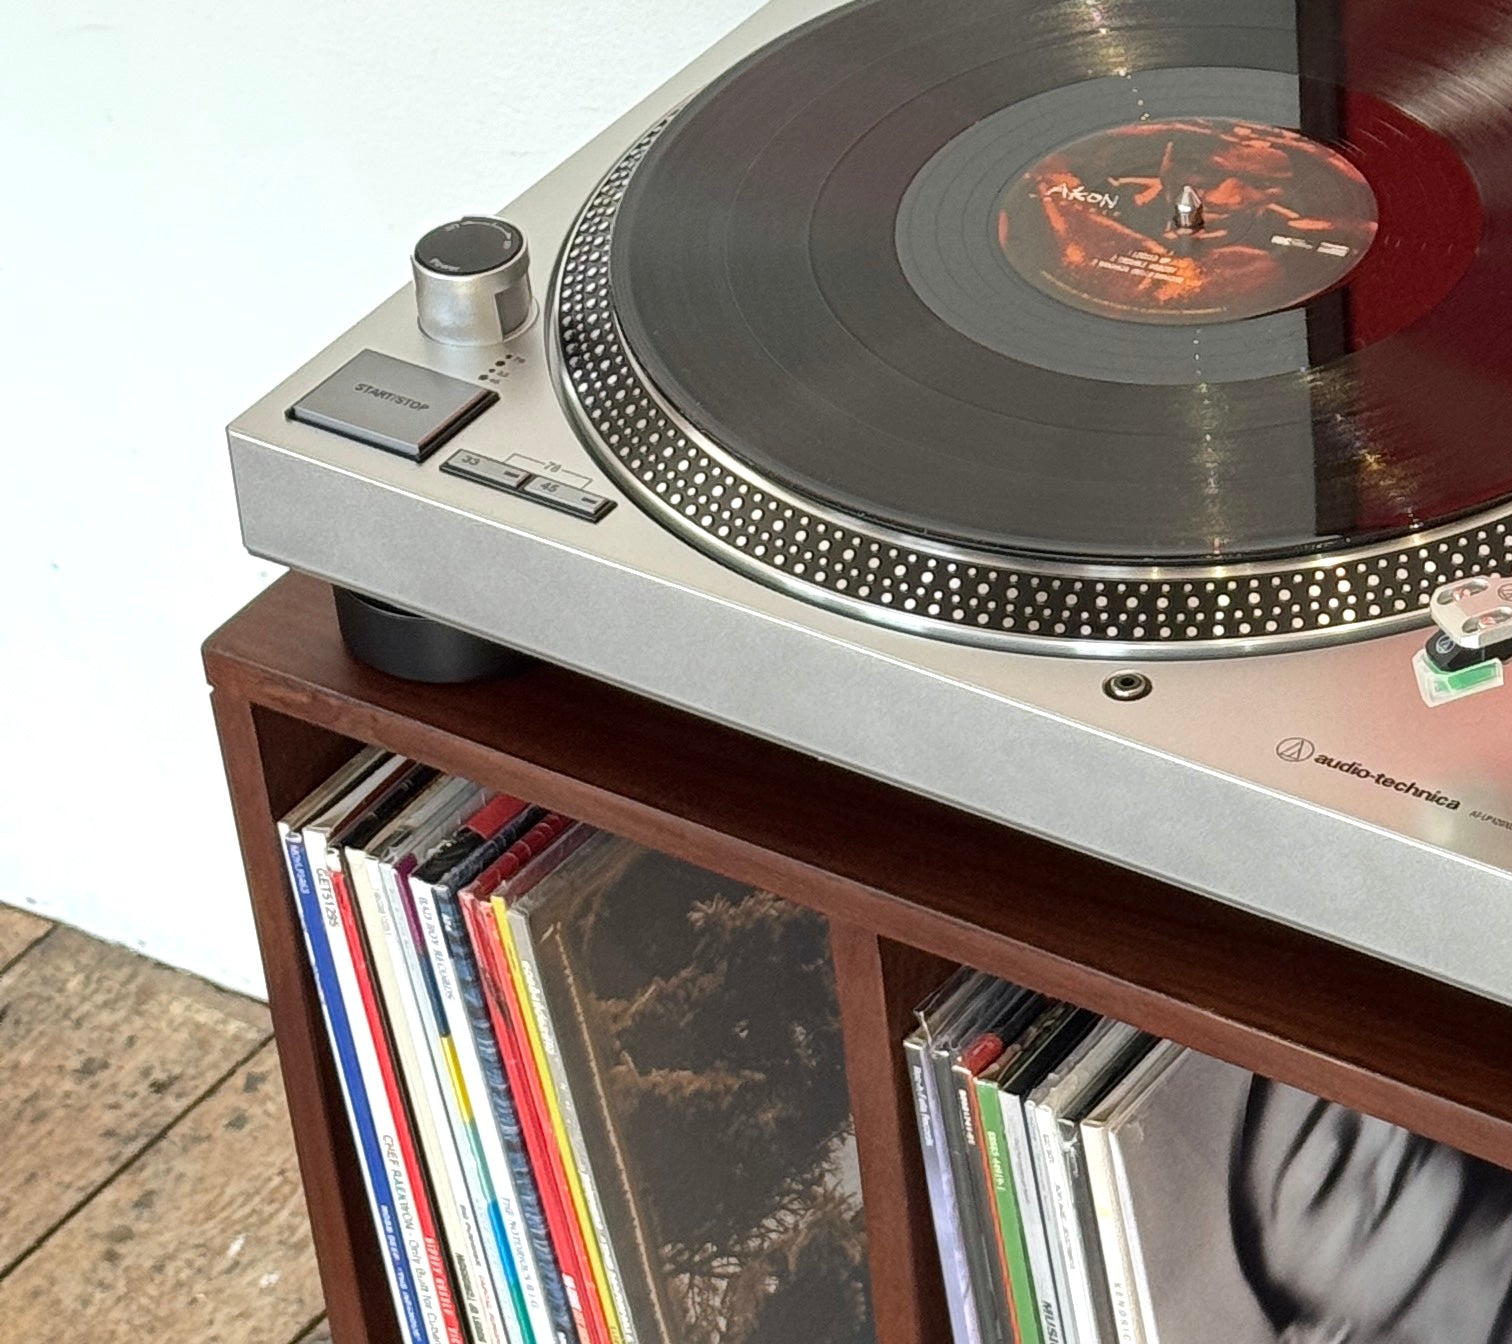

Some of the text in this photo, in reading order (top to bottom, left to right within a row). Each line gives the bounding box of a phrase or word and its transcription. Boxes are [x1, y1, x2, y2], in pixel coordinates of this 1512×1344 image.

[353, 382, 431, 413] START/STOP
[540, 481, 560, 494] 45
[1313, 752, 1461, 812] audio-technica
